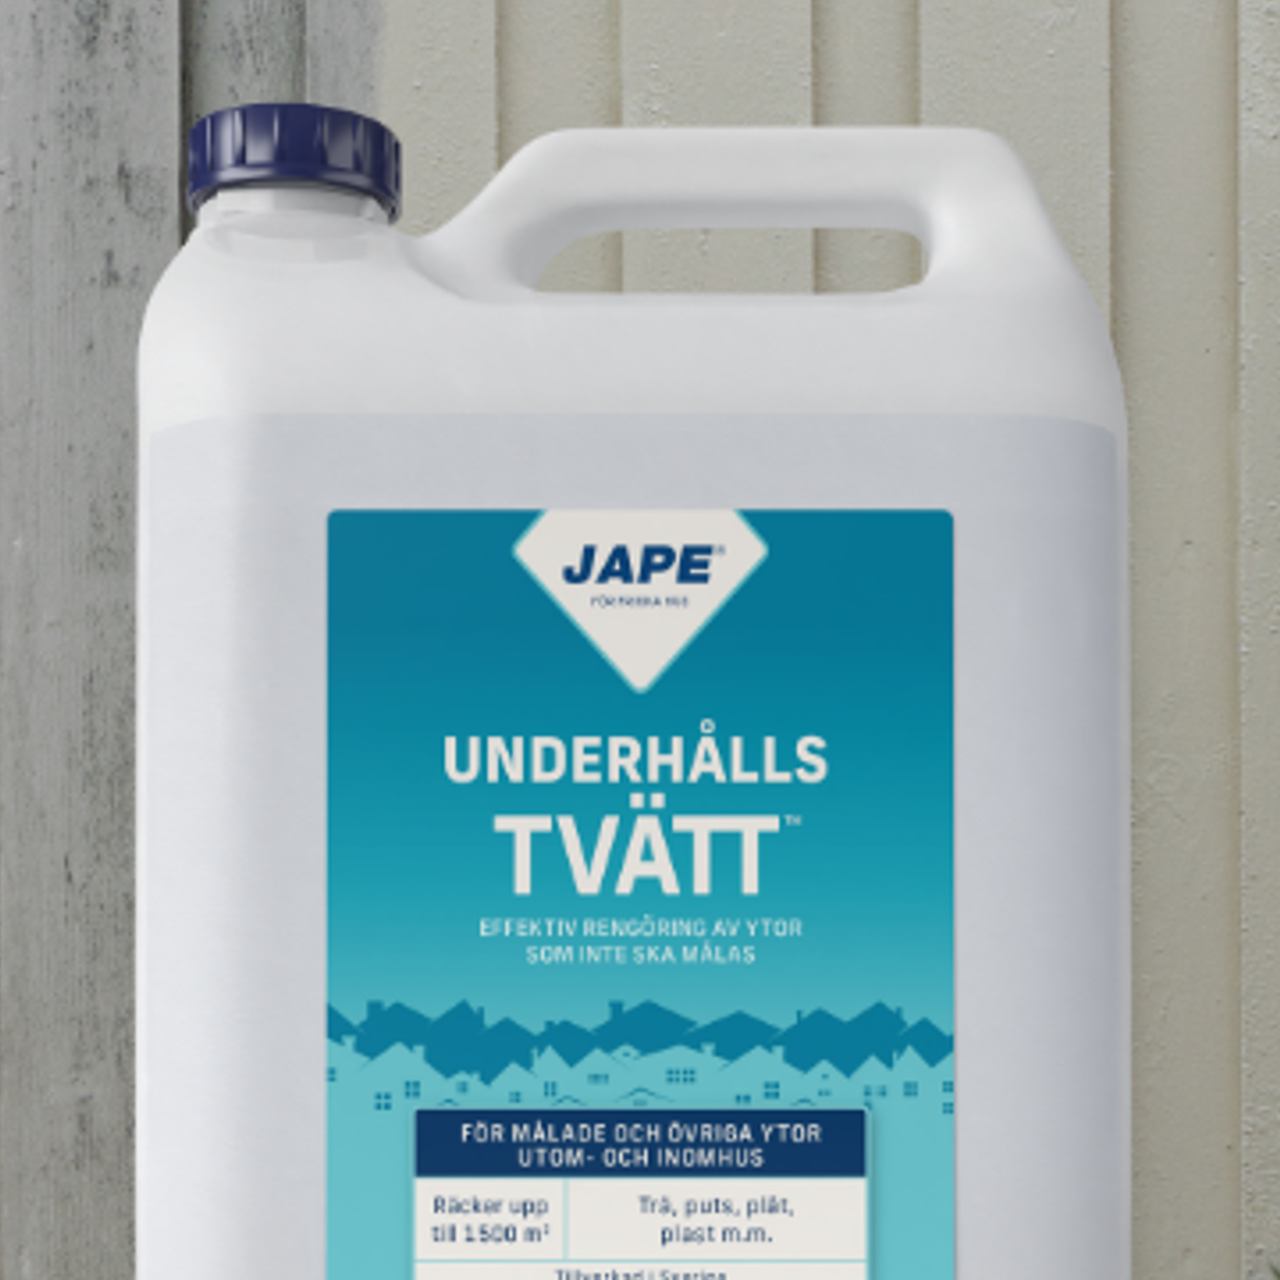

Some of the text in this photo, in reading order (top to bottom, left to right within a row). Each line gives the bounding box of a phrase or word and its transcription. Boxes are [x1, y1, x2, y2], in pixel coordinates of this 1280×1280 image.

[444, 718, 828, 783] UNDERHÅLLS
[479, 913, 802, 937] EFFEKTIV RENGÖRING AV YTOR
[526, 940, 756, 964] SOM INTE SKA MÅLAS
[461, 1119, 822, 1142] FÖR MÅLADE OCH ÖVRIGA YTOR
[518, 1148, 764, 1168] UTOM- OCH INOMHUS
[433, 1195, 549, 1219] Räcker upp
[685, 1197, 740, 1218] puts,
[431, 1223, 456, 1242] till
[660, 1224, 773, 1246] plast m.m.
